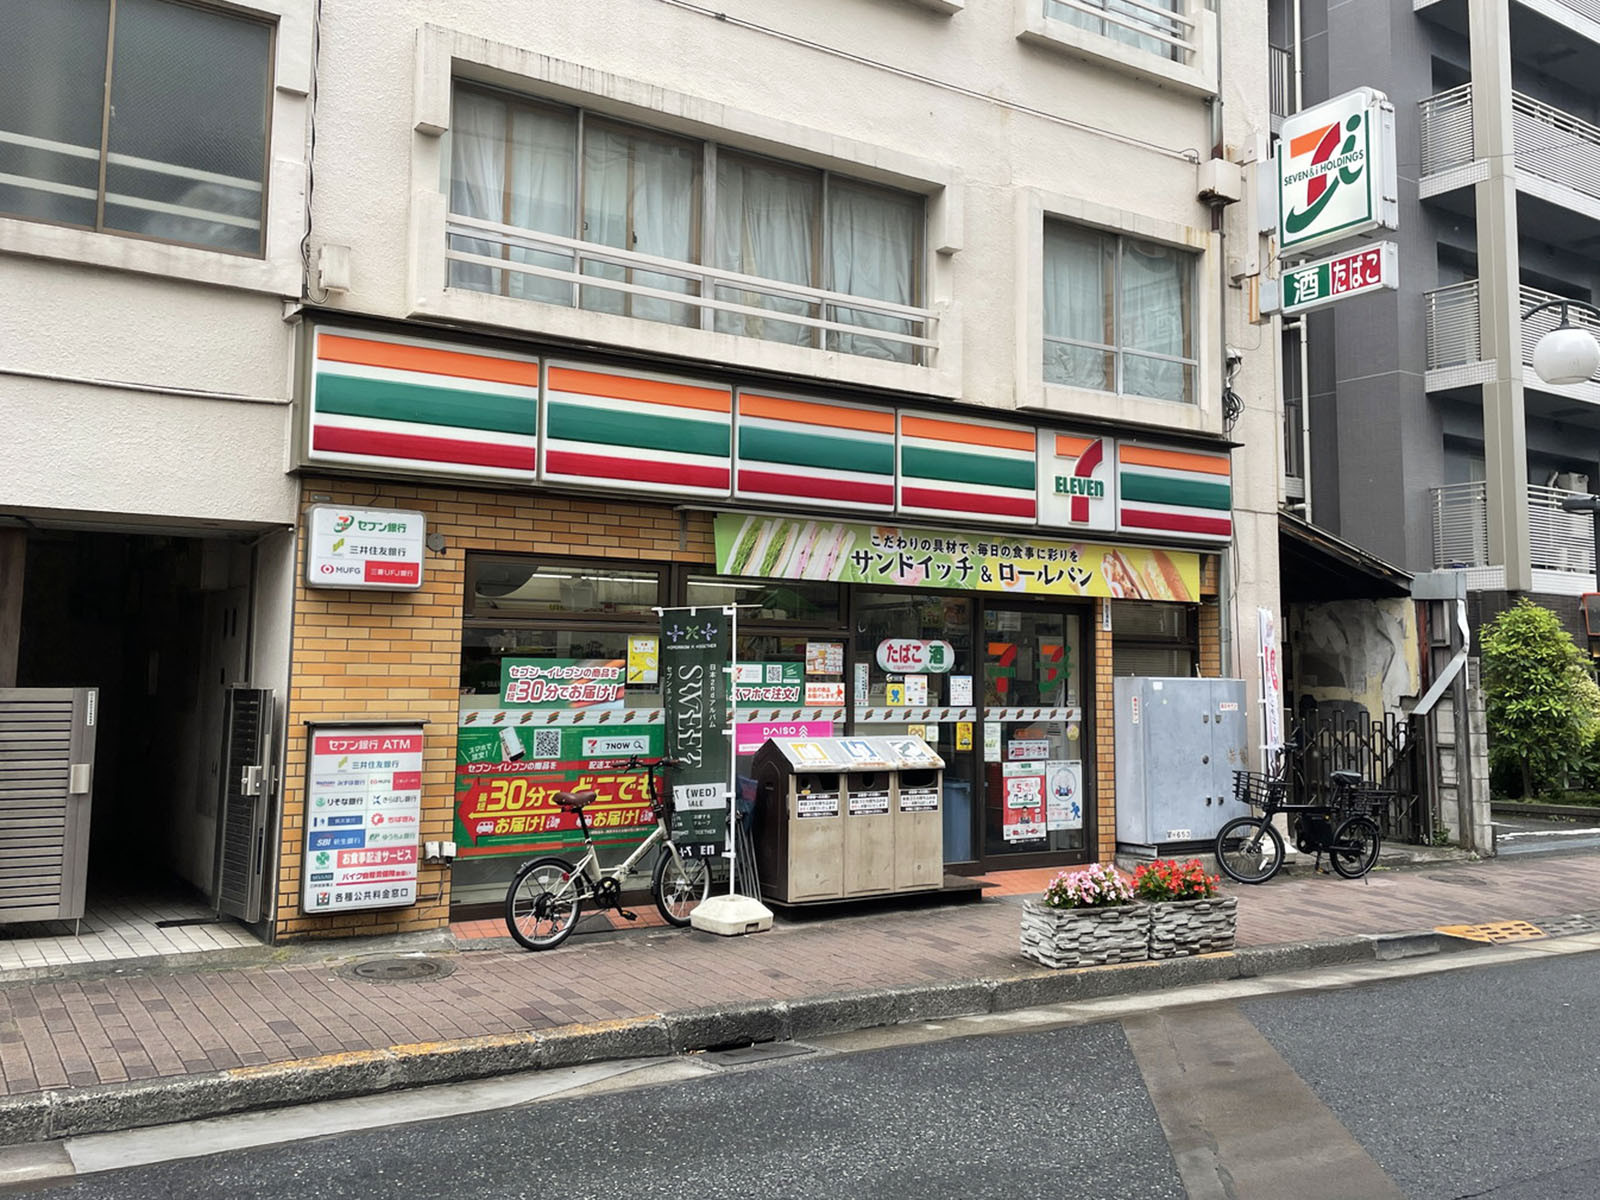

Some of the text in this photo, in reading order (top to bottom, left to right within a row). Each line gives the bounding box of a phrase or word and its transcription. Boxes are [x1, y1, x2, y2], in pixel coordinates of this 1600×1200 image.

[1320, 150, 1364, 174] HOLDINGS
[1293, 253, 1381, 304] 酒 たばこ
[358, 520, 407, 533] セブン銀行
[349, 545, 407, 557] 三井住友銀行
[851, 549, 1093, 587] サンドイッチ & ロールパン
[887, 643, 944, 664] たばこ 酒
[709, 663, 718, 728] 日本2ndアルバム
[763, 727, 796, 735] DAISO
[329, 739, 411, 751] セブン銀行 ATM
[605, 742, 630, 750] 7NOW
[352, 760, 400, 769] 三井住友銀行
[327, 797, 363, 806] りそな銀行
[593, 809, 640, 827] お届け!
[494, 816, 546, 834] お届け!
[316, 838, 331, 846] SBI
[336, 888, 408, 902] 各種公共料金窓口
